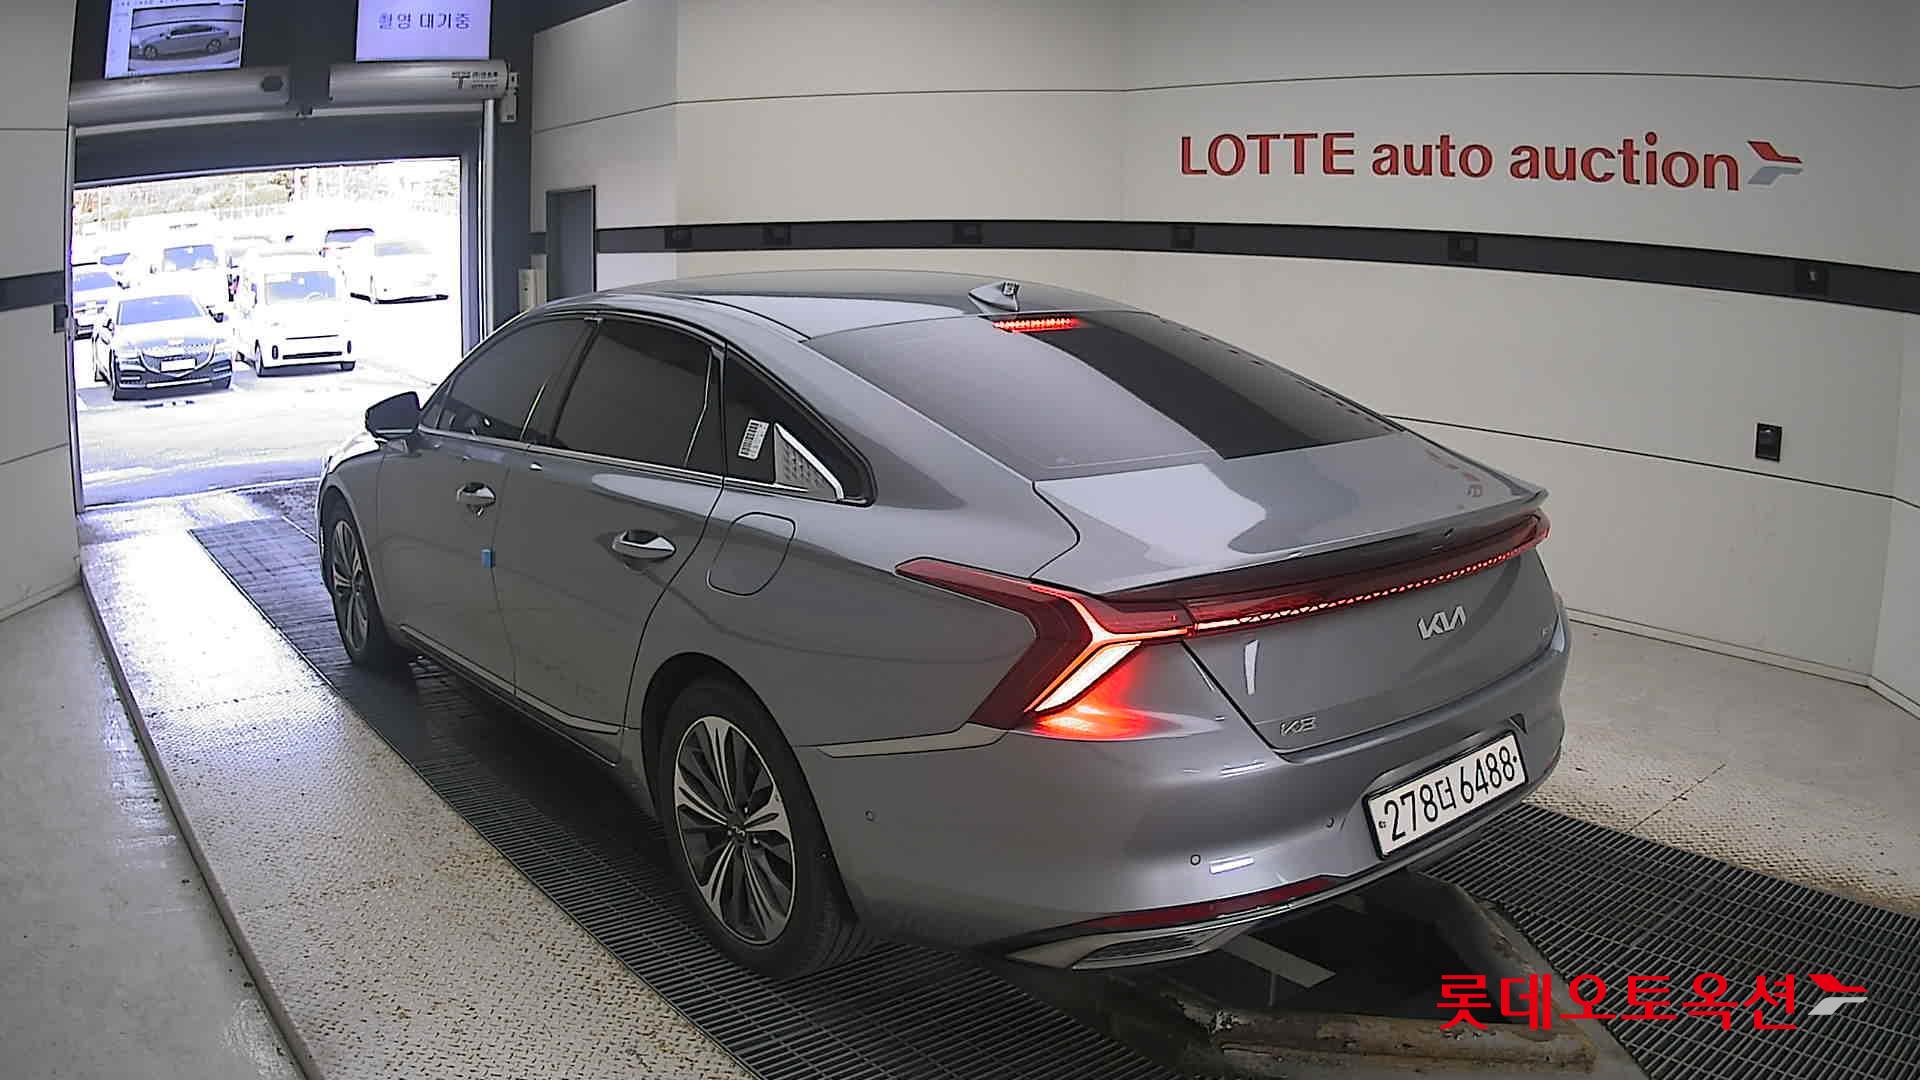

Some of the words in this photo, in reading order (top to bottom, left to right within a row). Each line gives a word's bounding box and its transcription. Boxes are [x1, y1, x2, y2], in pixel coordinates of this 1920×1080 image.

[419, 12, 470, 29] 대기중
[1181, 132, 1355, 176] LOTTE
[1372, 135, 1494, 178] auto
[1510, 131, 1740, 191] auction
[1417, 604, 1467, 641] KIA
[1459, 745, 1516, 804] 6488
